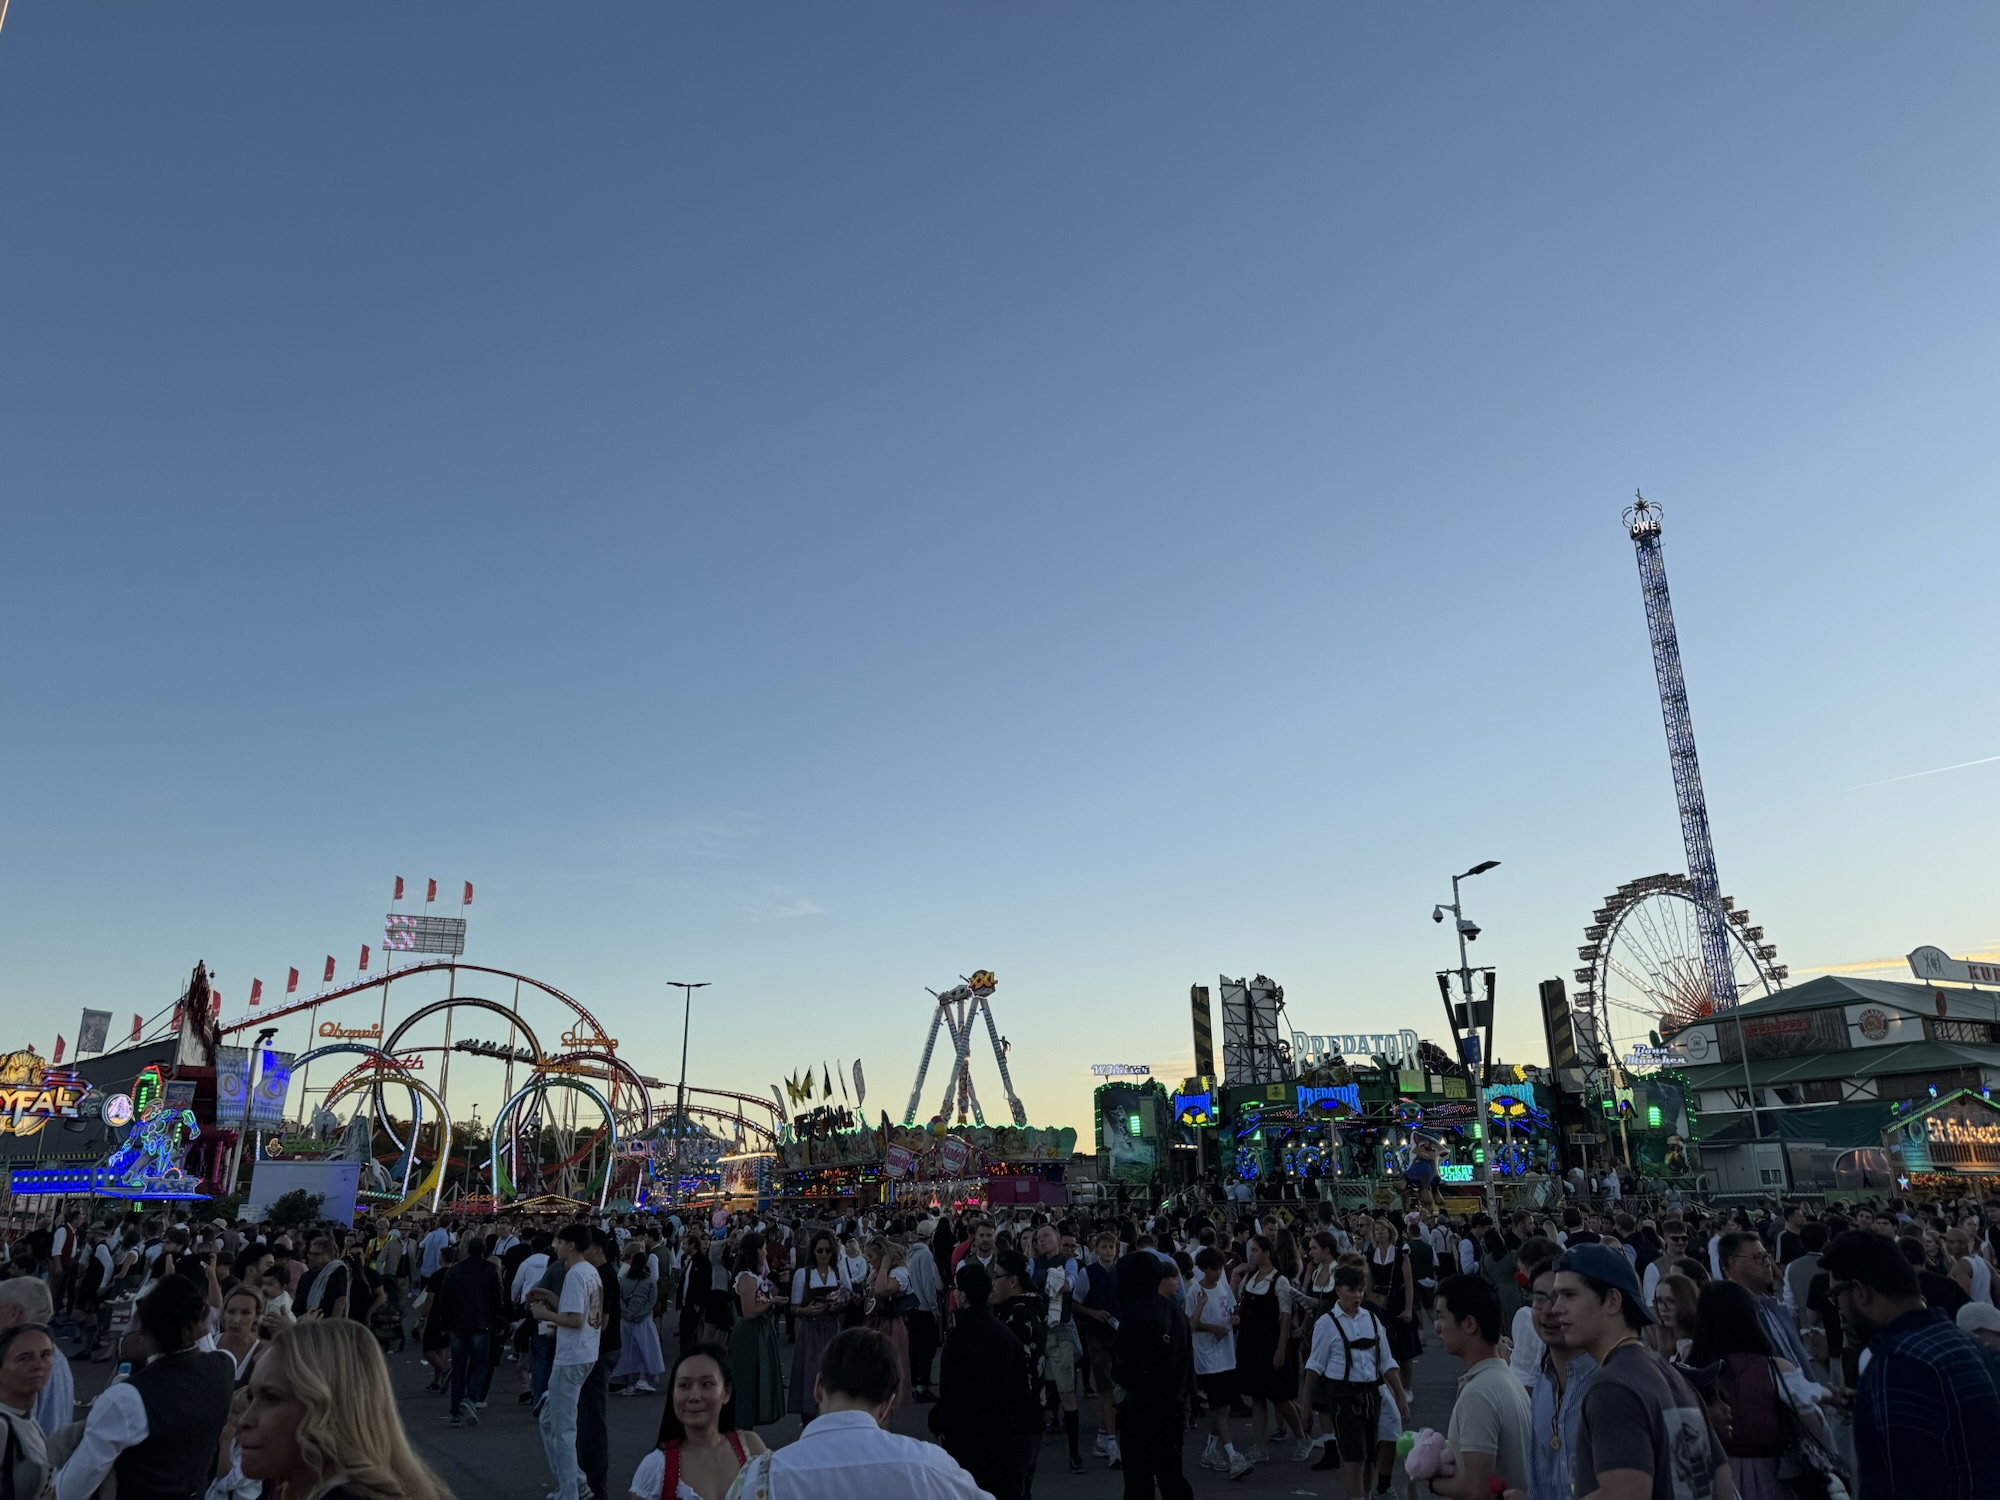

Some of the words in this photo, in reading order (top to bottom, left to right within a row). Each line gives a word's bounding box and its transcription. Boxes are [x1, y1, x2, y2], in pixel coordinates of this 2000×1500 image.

[970, 971, 998, 989] XXL
[319, 1022, 384, 1040] Olympia
[561, 1031, 618, 1049] Looping
[1291, 1029, 1421, 1078] PREDATOR
[1633, 1044, 1671, 1056] Bonn
[1623, 1054, 1688, 1066] München
[0, 1087, 79, 1127] YFALL
[1296, 1083, 1363, 1117] PREDATOR
[1439, 1165, 1474, 1175] TICKET
[146, 1181, 195, 1193] KASSE
